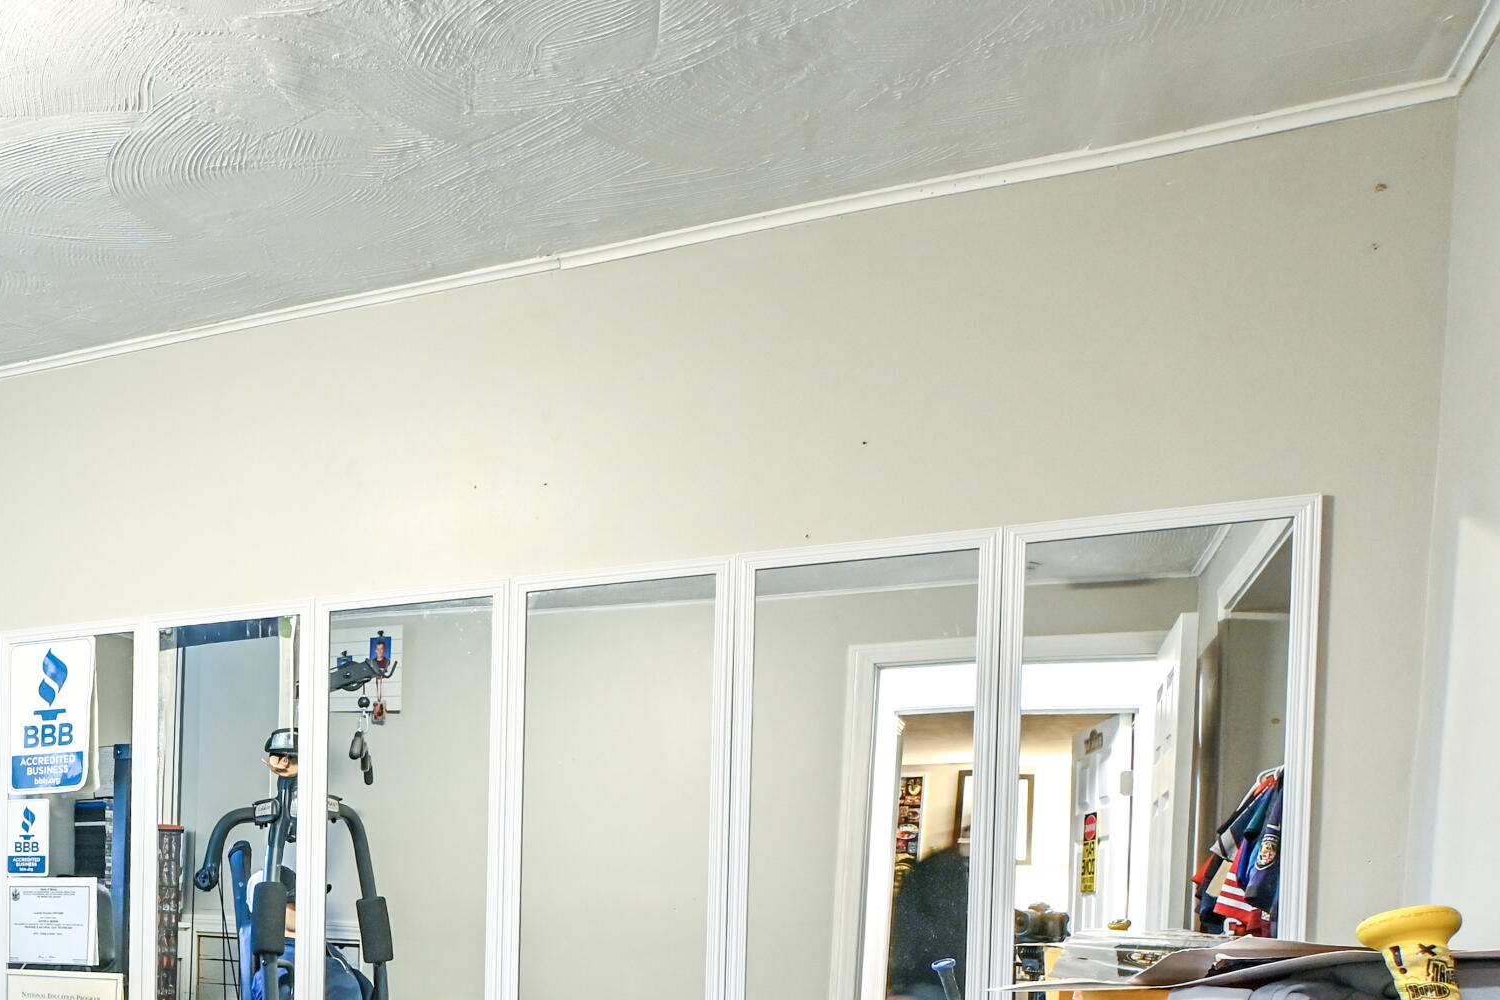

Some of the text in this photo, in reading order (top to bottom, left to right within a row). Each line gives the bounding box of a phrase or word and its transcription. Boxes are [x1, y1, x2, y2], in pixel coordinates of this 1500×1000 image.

[24, 722, 74, 748] BBB
[20, 754, 76, 766] ACCREDITED
[26, 765, 69, 776] BUSINESS
[34, 777, 61, 785] bbb.org
[14, 842, 40, 852] BBB
